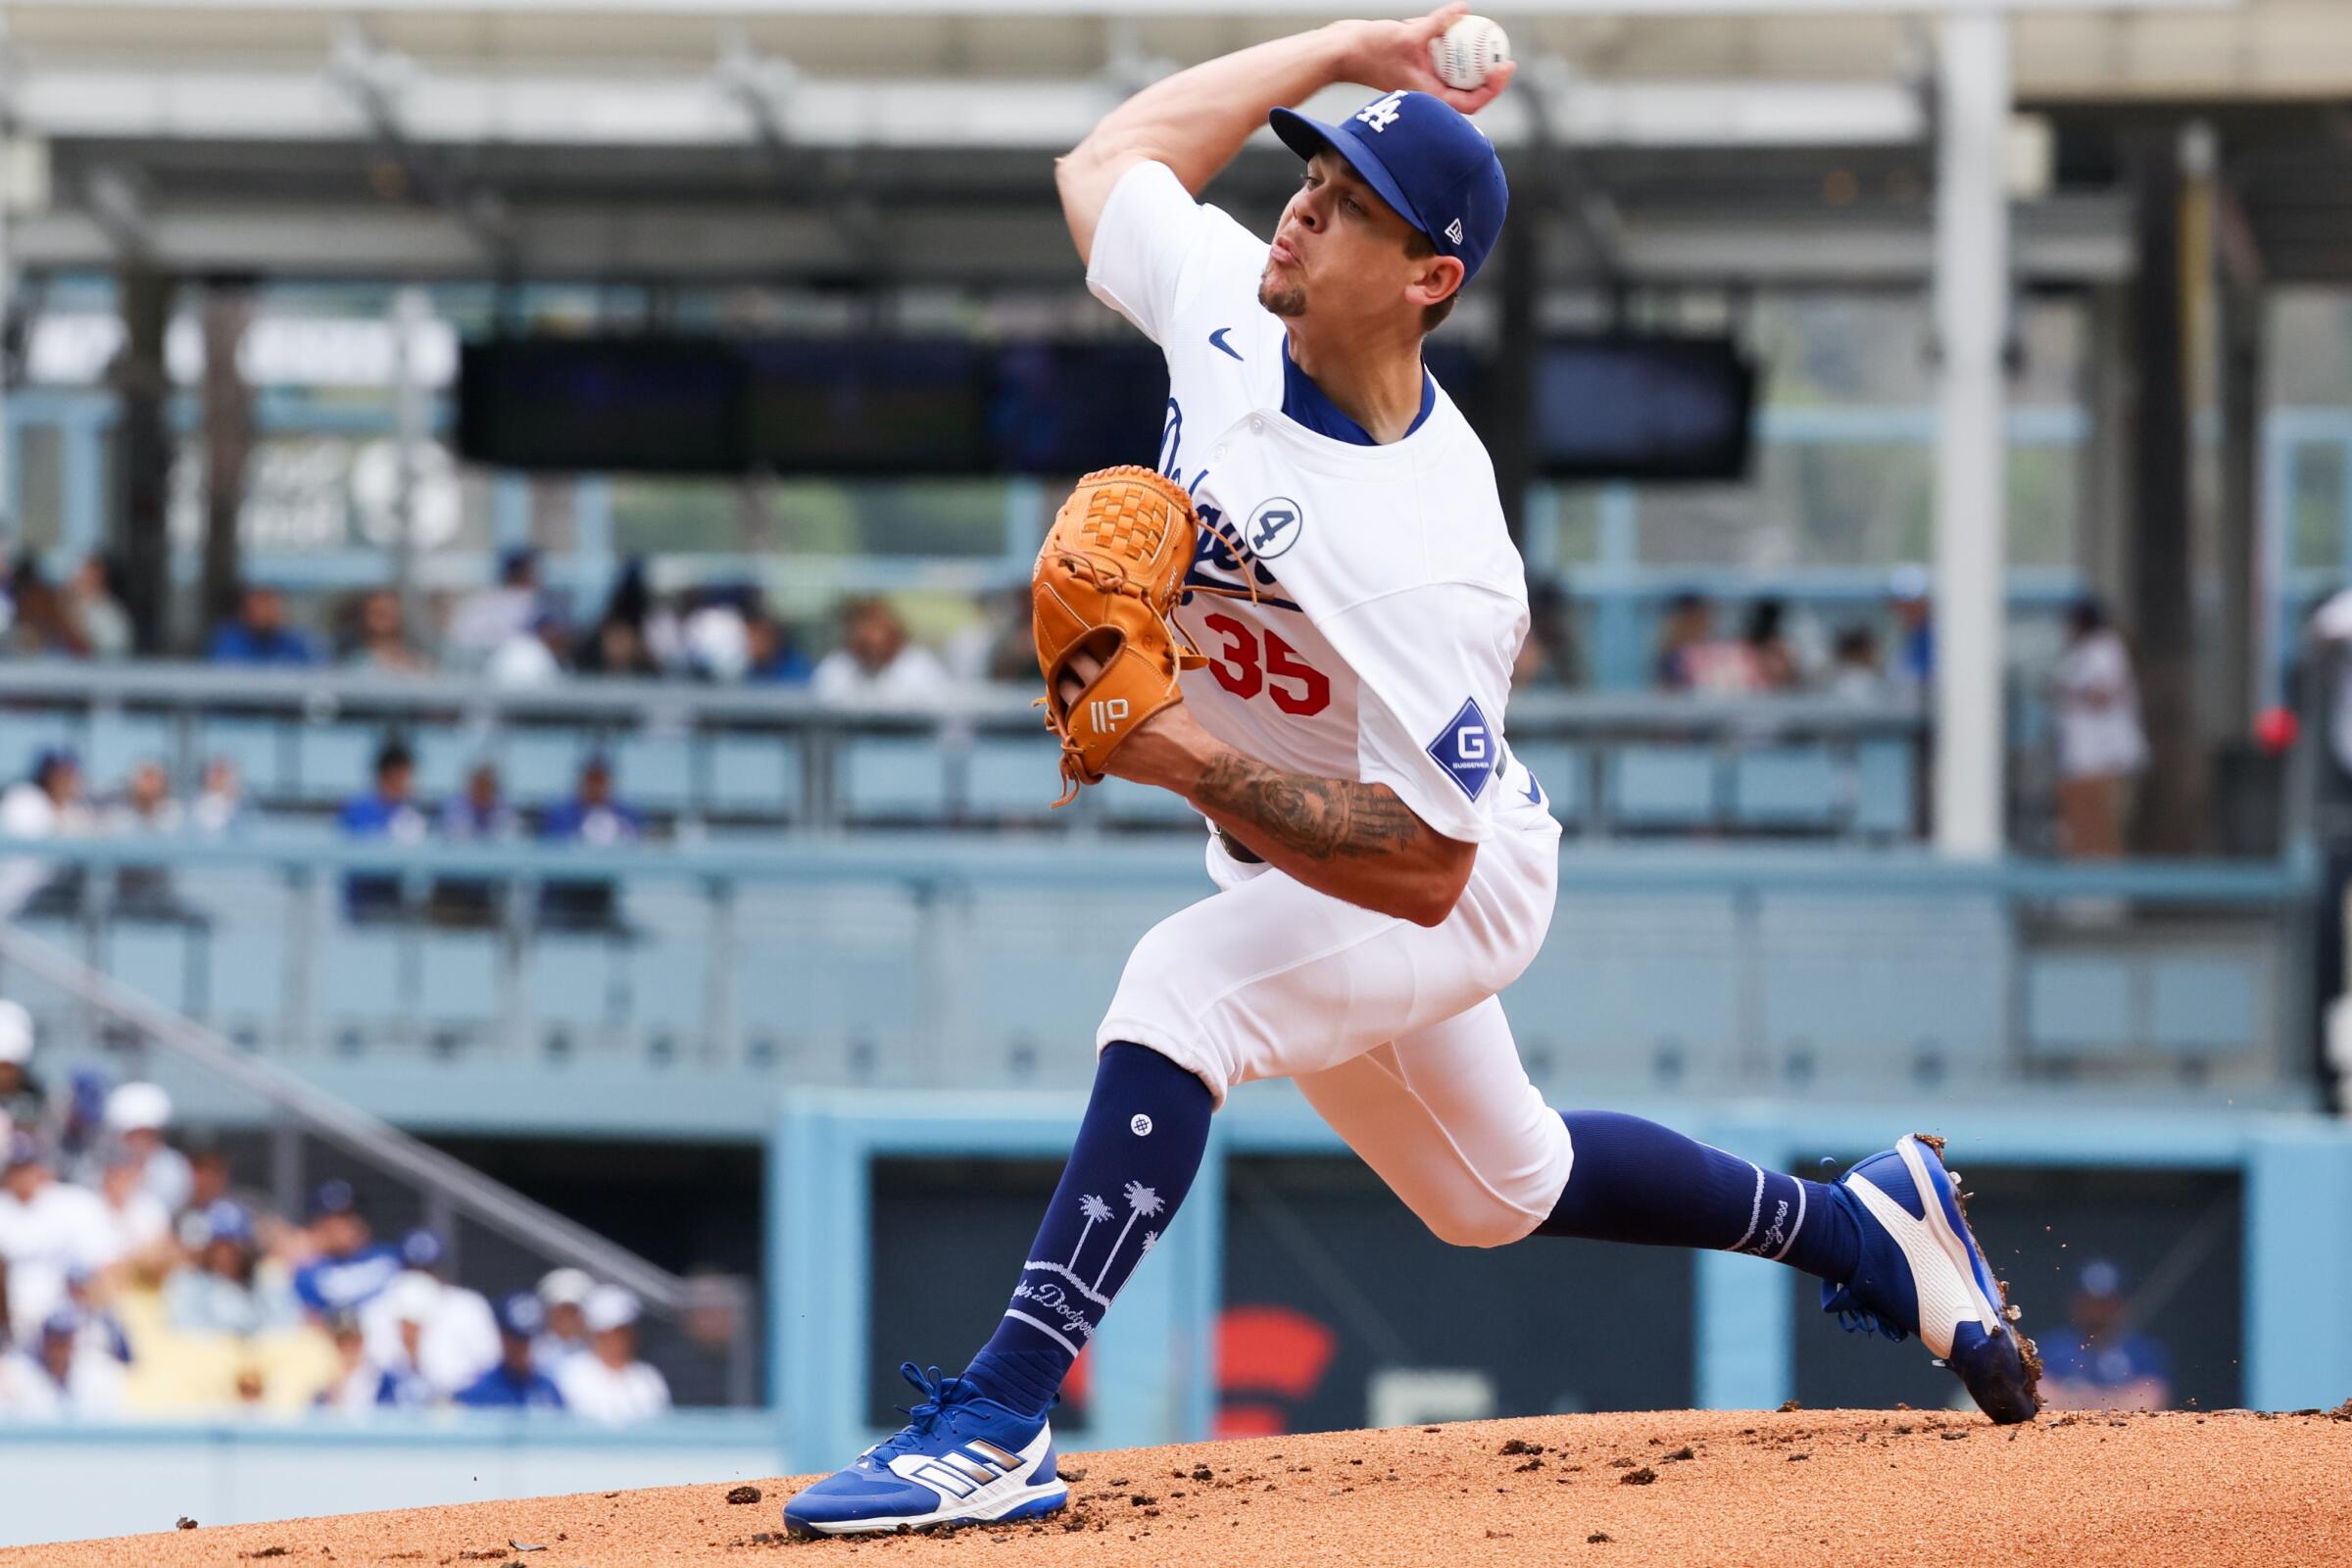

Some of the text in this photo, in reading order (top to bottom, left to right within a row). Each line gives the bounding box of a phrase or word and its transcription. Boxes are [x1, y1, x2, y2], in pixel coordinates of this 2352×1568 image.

[1356, 89, 1408, 133] LA
[1252, 511, 1296, 551] 4
[1204, 612, 1330, 716] 35
[1457, 726, 1485, 759] G
